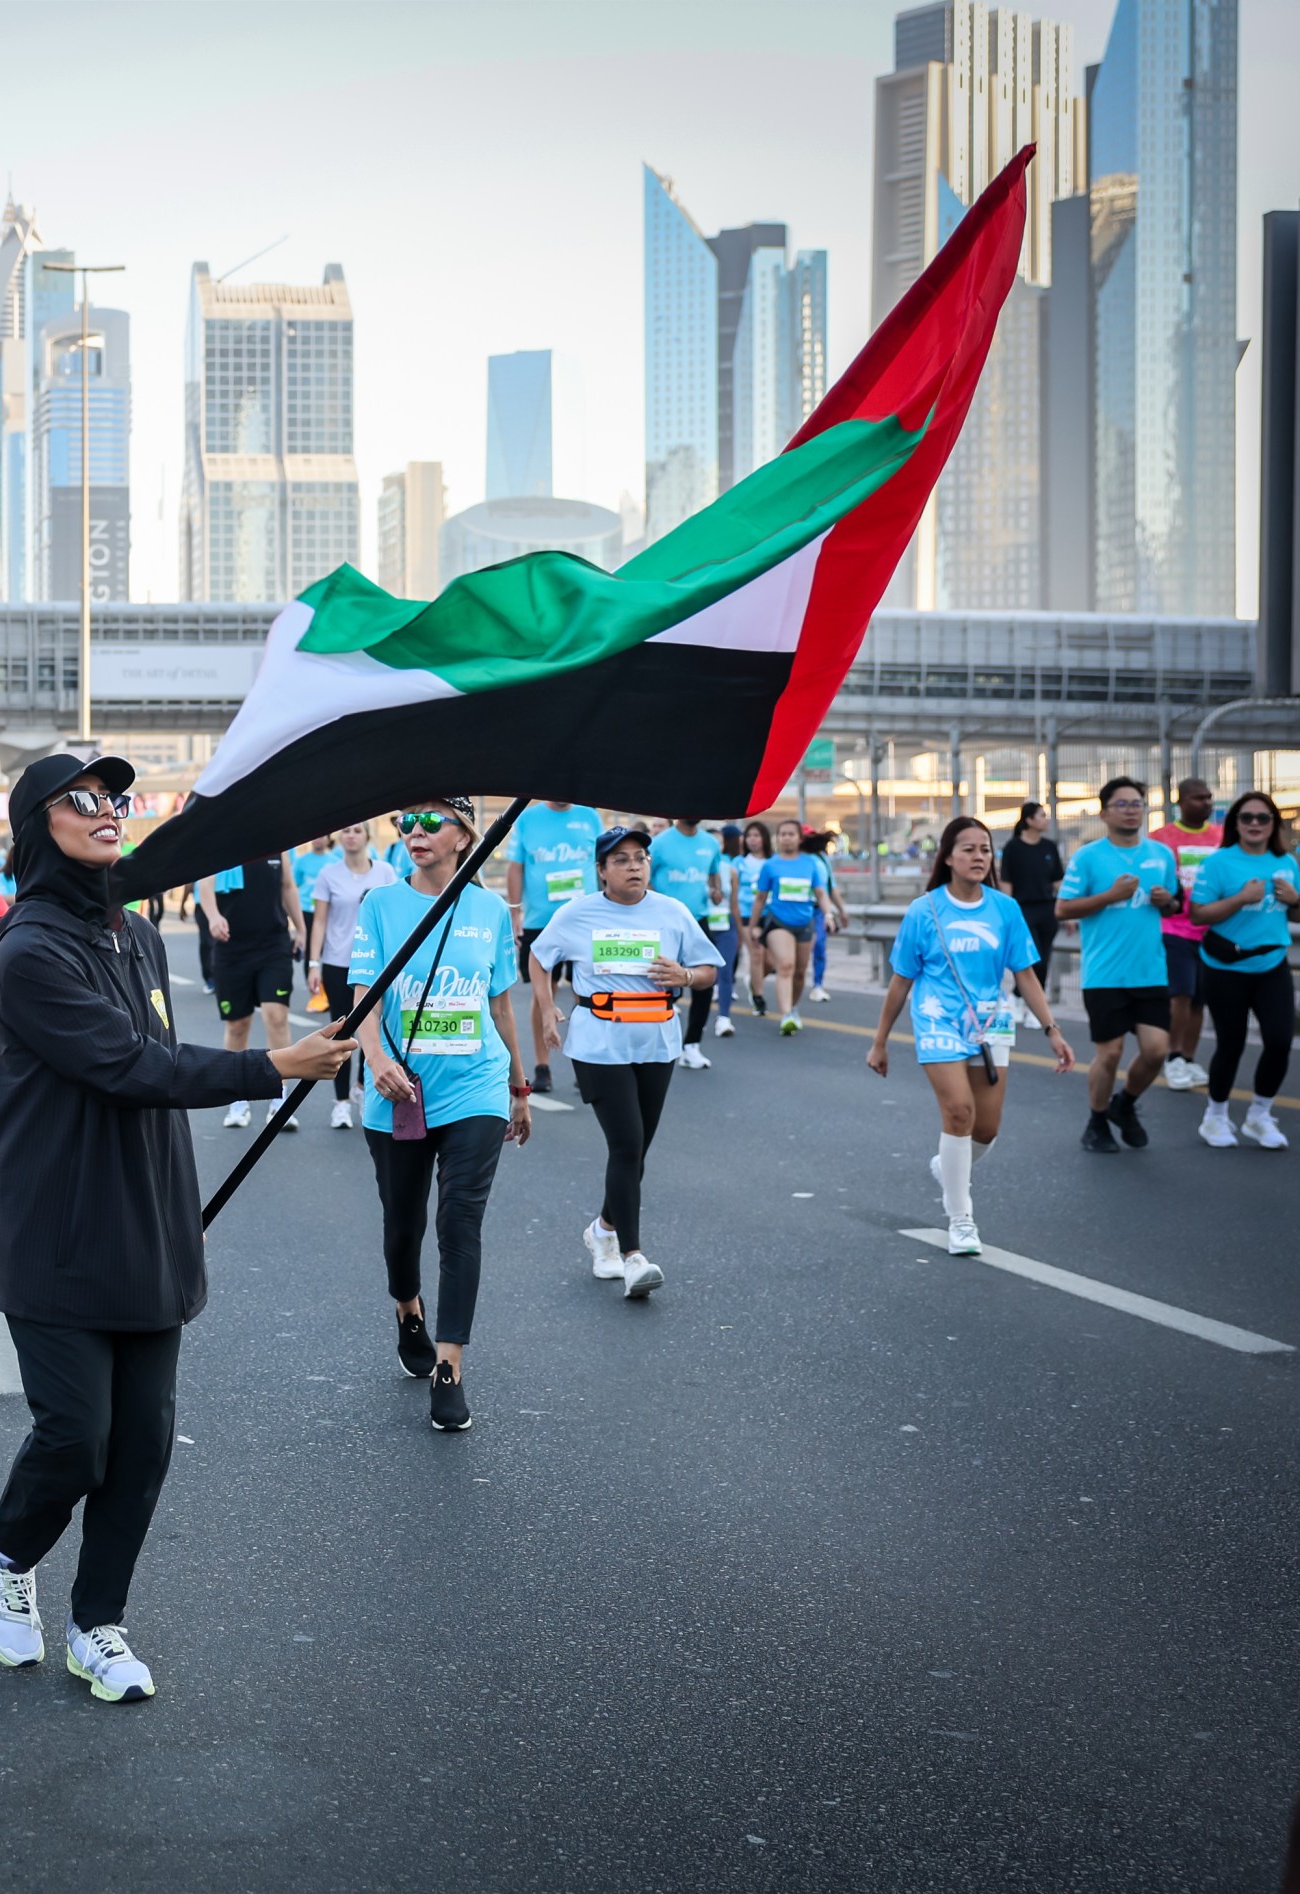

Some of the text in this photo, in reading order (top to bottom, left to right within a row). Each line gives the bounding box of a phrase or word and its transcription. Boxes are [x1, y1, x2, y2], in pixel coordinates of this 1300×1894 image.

[454, 929, 478, 938] RUN
[949, 937, 980, 952] ANTA
[599, 947, 640, 956] 183290
